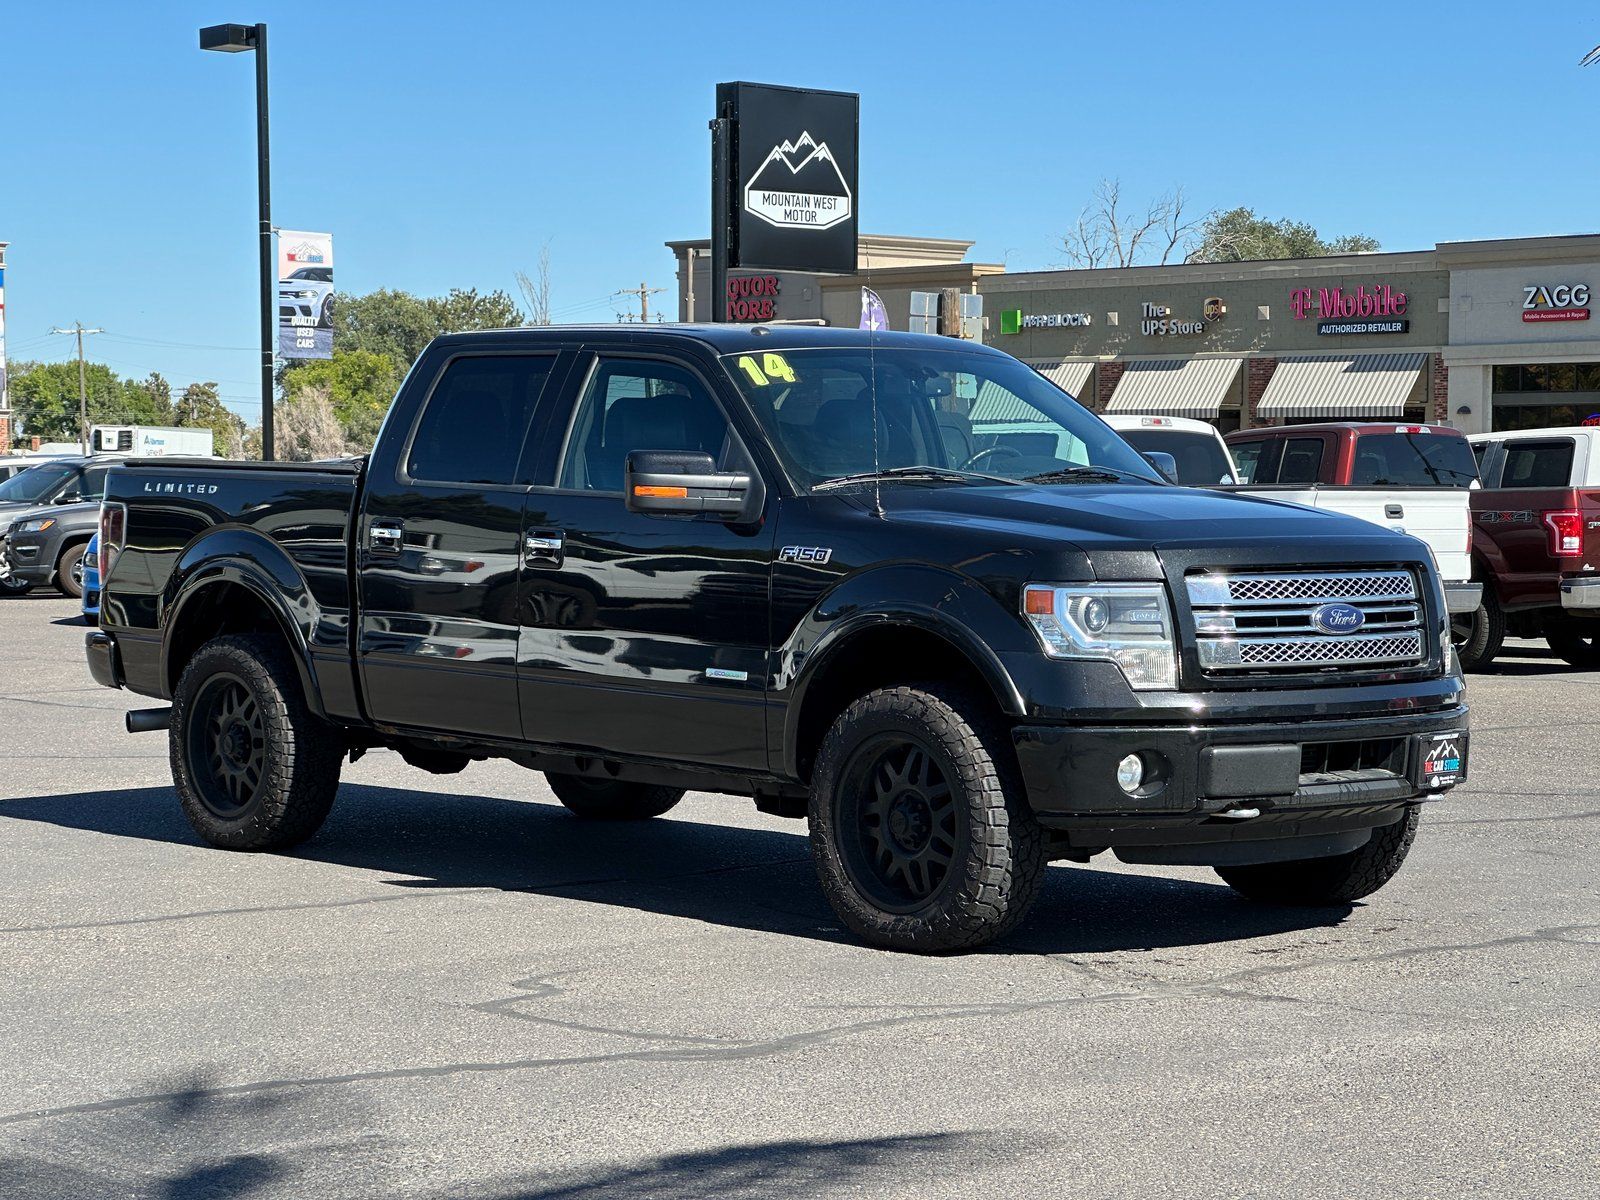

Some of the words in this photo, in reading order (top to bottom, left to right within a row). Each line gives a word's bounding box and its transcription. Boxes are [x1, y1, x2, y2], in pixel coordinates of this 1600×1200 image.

[762, 192, 811, 208] MOUNTAIN
[813, 196, 838, 210] WEST
[784, 208, 817, 222] MOTOR
[727, 275, 778, 300] QUOR
[1523, 284, 1589, 309] ZAGG
[1142, 302, 1166, 317] The
[1205, 304, 1219, 318] ups
[291, 316, 319, 327] QUALITY
[1048, 312, 1090, 327] BLOCK
[296, 327, 315, 338] USED
[1142, 320, 1168, 336] UPS
[1169, 319, 1203, 335] Store
[1320, 323, 1367, 334] AUTHORIZED
[1368, 322, 1402, 332] RETAILER
[296, 338, 315, 349] CARS
[739, 353, 796, 386] 14
[144, 482, 218, 494] LIMITED
[1330, 609, 1357, 626] Ford
